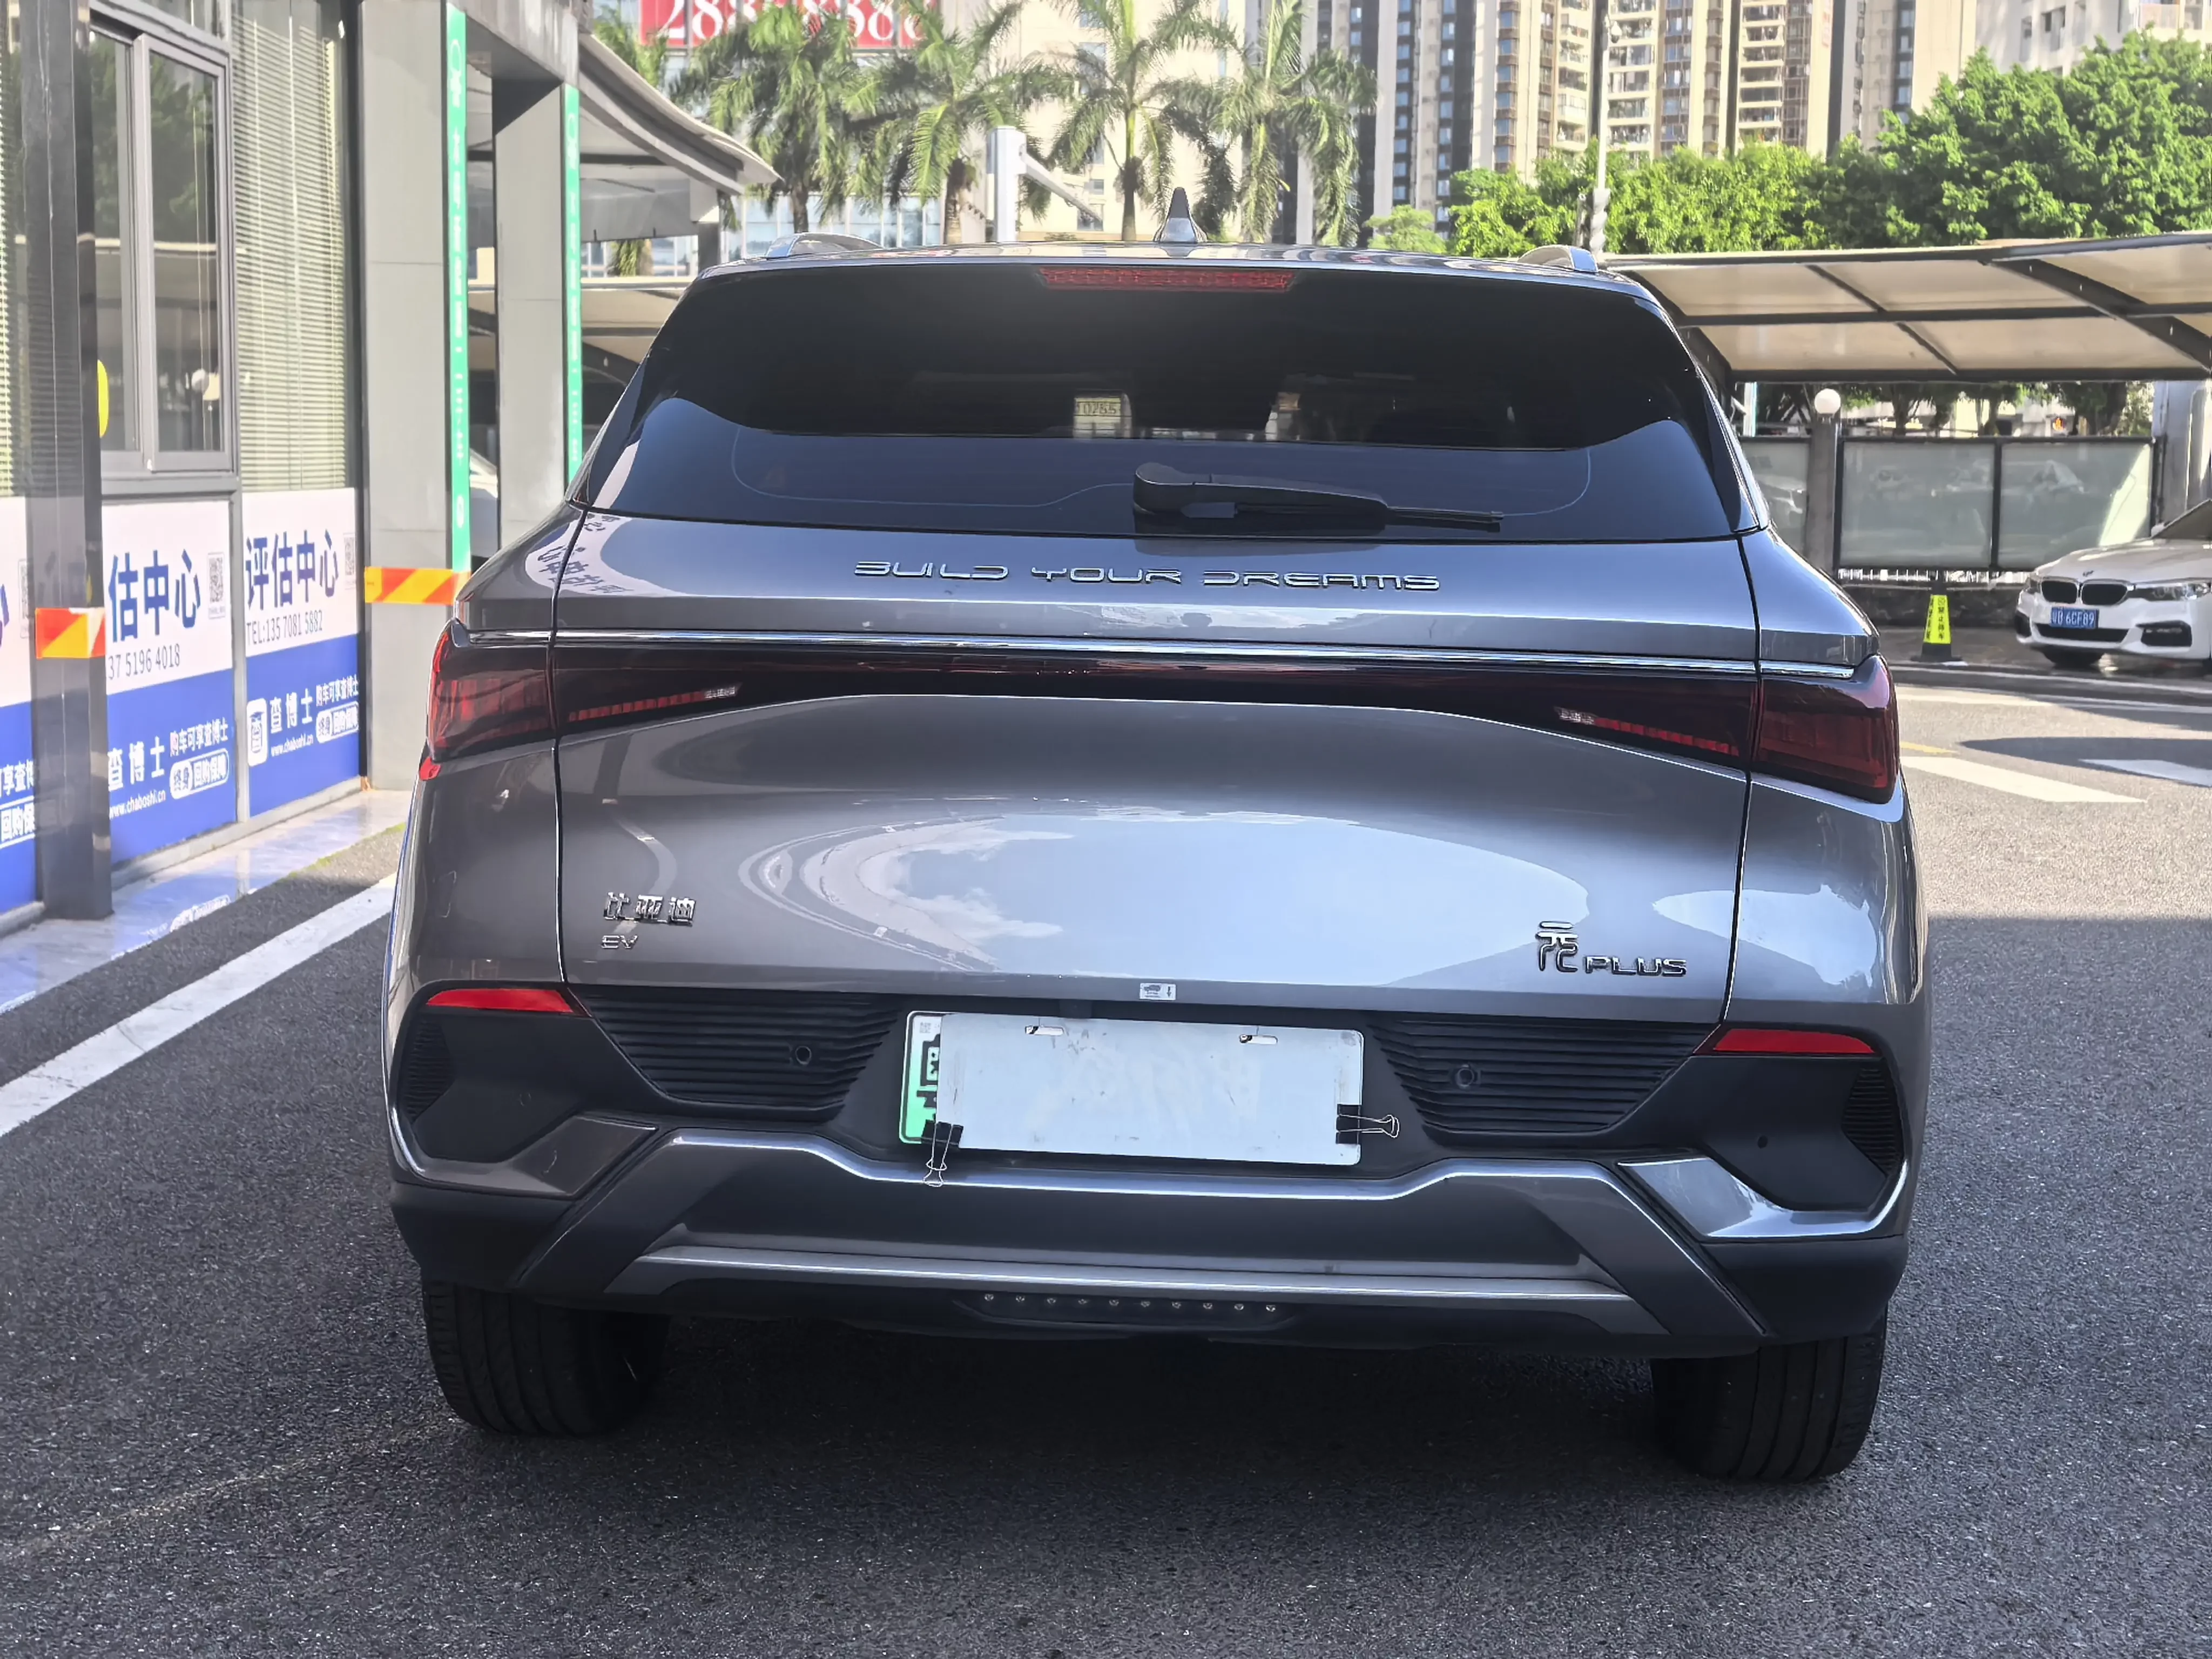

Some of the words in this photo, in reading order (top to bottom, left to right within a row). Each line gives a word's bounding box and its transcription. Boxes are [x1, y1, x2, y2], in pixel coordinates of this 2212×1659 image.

[245, 529, 339, 610] 评估中心
[855, 562, 1009, 581] BUILD
[1031, 567, 1182, 584] YOUR
[1203, 570, 1440, 590] DREAMS
[108, 549, 200, 643] 估中心
[283, 612, 302, 638] 7081
[108, 655, 122, 680] 37
[125, 648, 152, 677] 5196
[155, 643, 180, 670] 4018
[270, 688, 313, 733] 查博士
[170, 717, 228, 757] 购车可享查博士
[107, 736, 165, 792] 查博士
[109, 789, 166, 820] www.chaboshi.cn
[604, 892, 695, 921] 比亚迪
[602, 935, 638, 949] EV
[1584, 955, 1687, 976] PLUS
